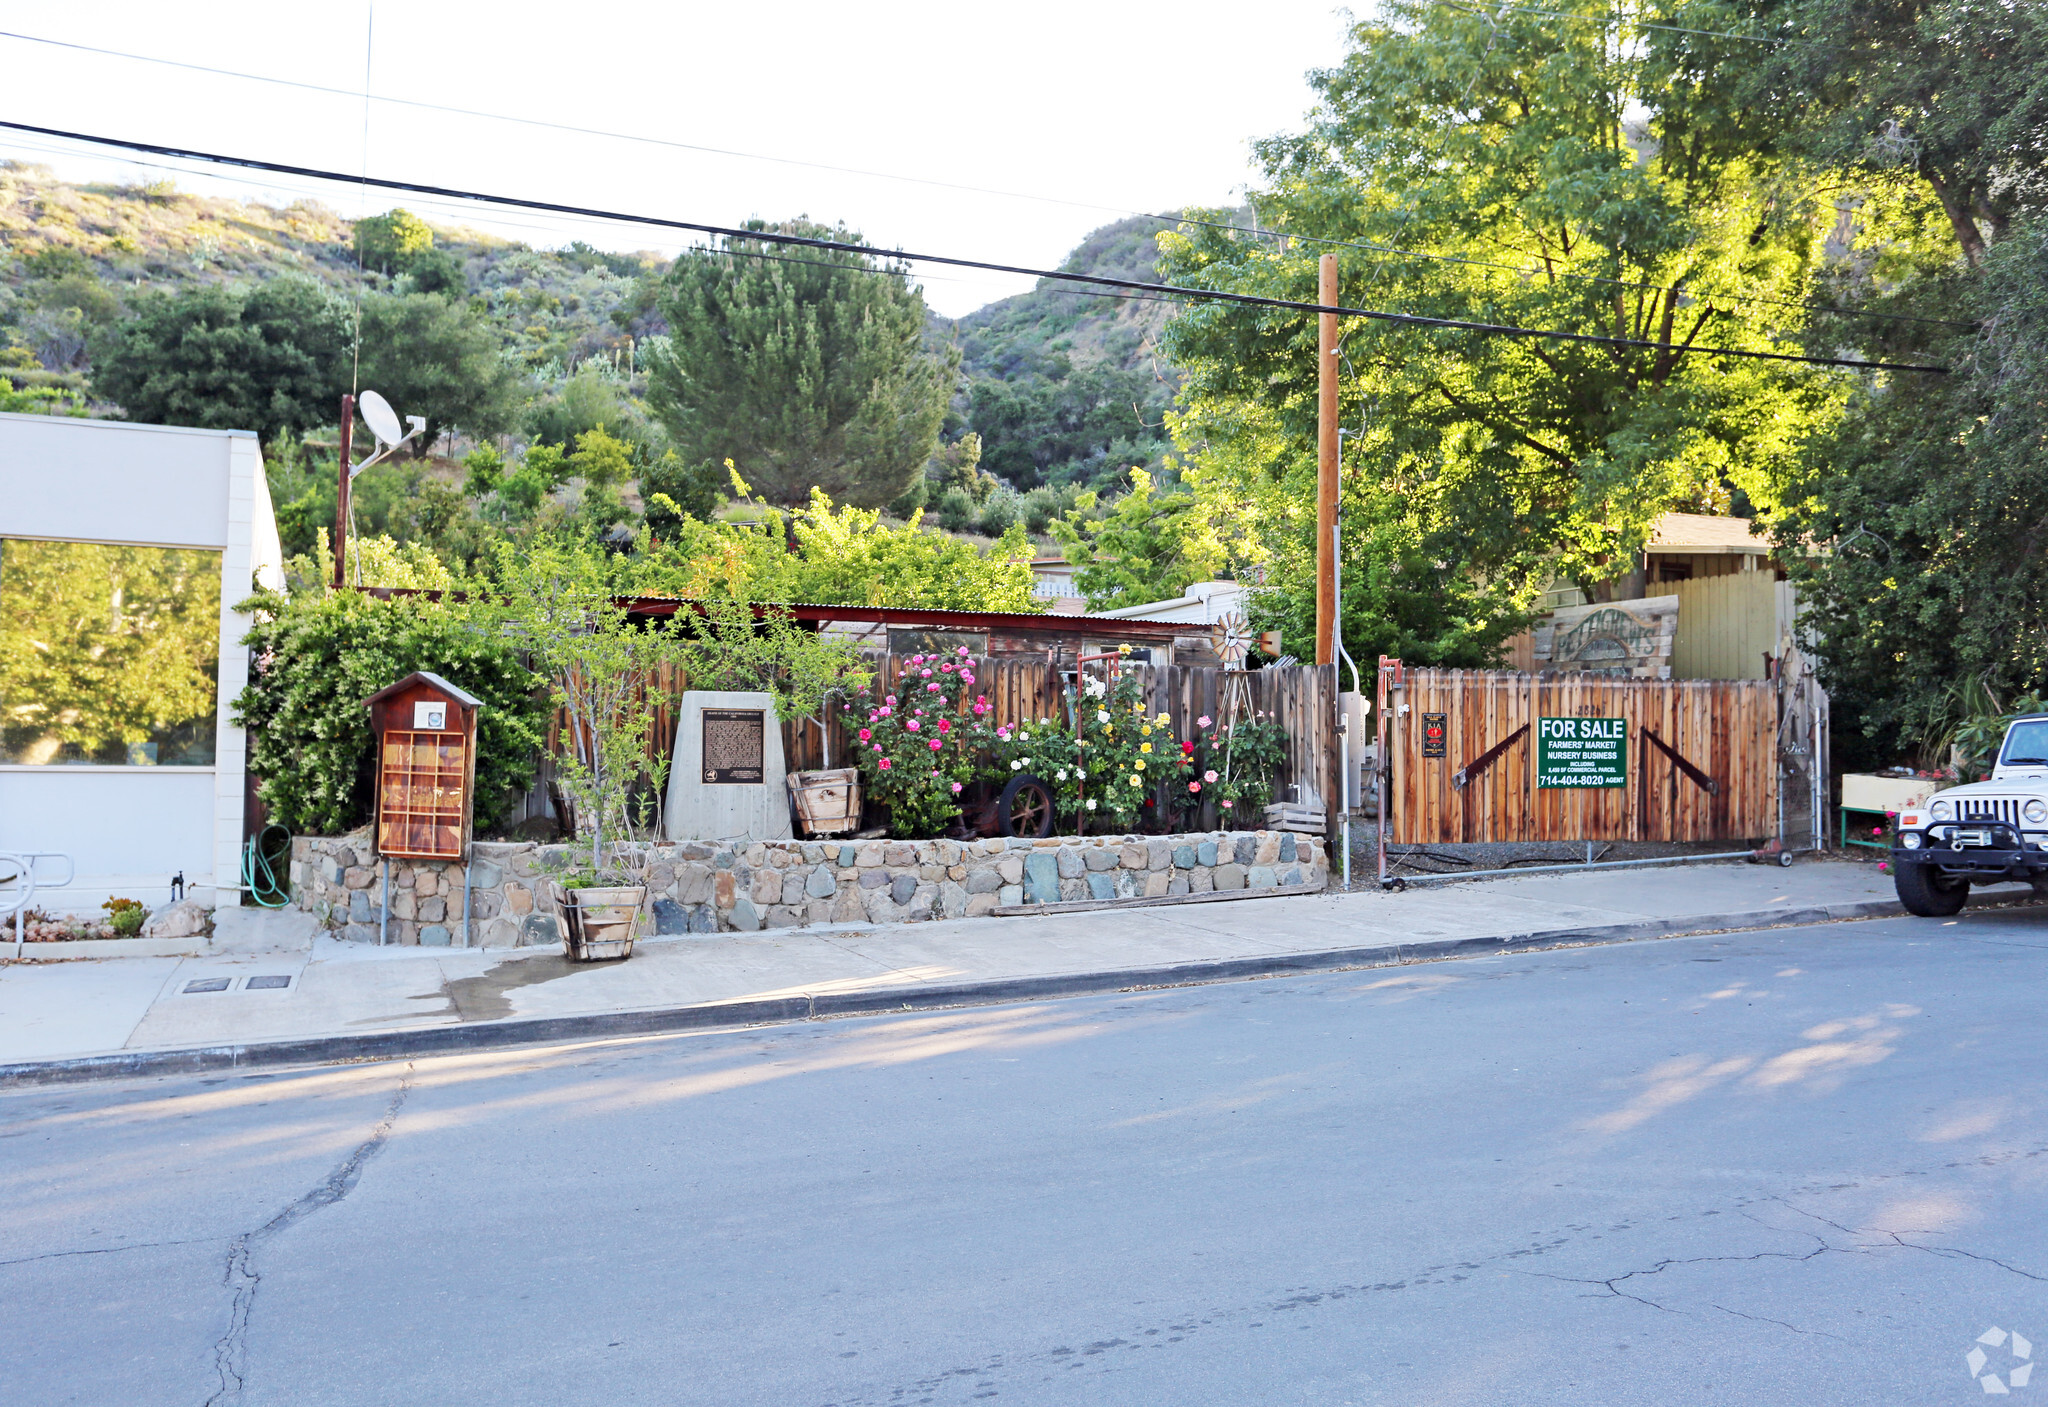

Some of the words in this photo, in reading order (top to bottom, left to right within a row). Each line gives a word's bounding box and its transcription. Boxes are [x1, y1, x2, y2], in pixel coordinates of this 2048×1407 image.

[1541, 720, 1576, 738] FOR
[1580, 720, 1624, 738] SALE
[1548, 741, 1584, 749] FARMERS'
[1585, 741, 1616, 749] MARKET/
[1547, 751, 1581, 760] NURSERY
[1582, 751, 1618, 760] BUSINESS
[1540, 775, 1604, 786] 714-404-8020
